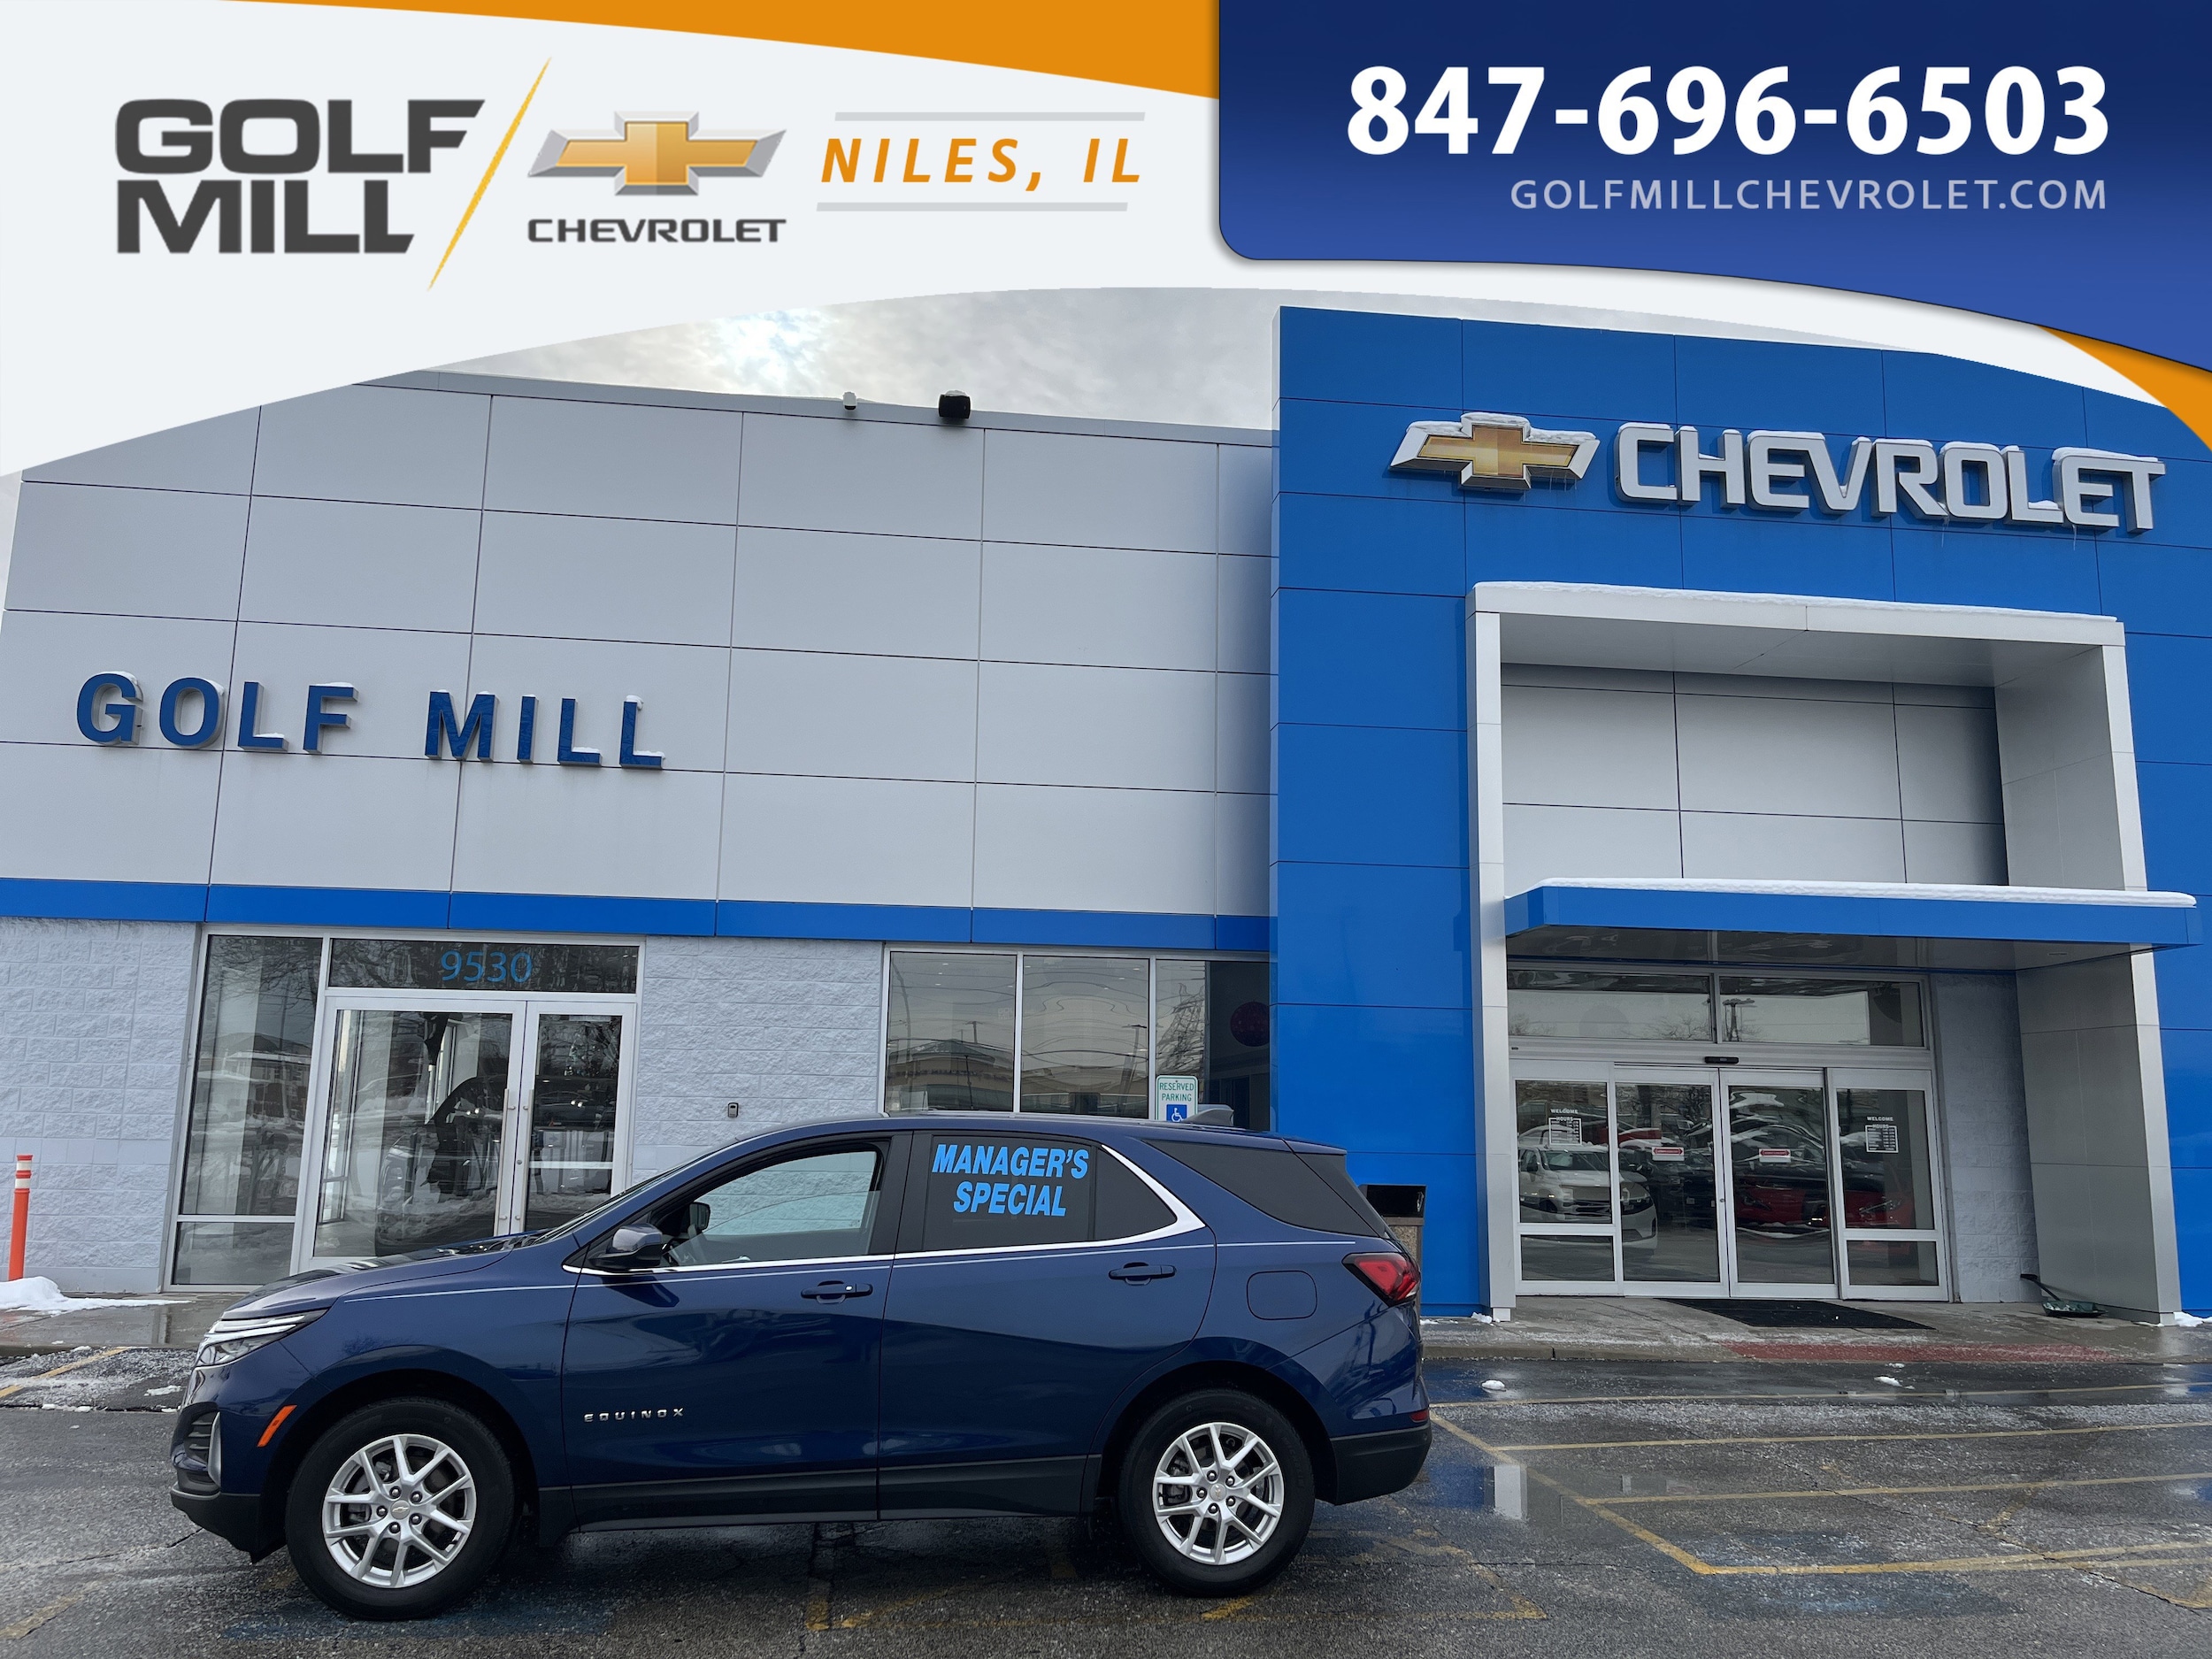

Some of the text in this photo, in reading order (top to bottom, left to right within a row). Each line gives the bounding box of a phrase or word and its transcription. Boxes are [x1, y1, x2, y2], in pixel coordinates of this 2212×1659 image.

[1616, 423, 2166, 532] CHEVROLET
[76, 671, 664, 770] GOLF MILL
[441, 949, 533, 983] 9530
[932, 1143, 1089, 1179] MANAGER'S
[953, 1180, 1067, 1217] SPECIAL
[583, 1408, 684, 1423] EQUINOX
